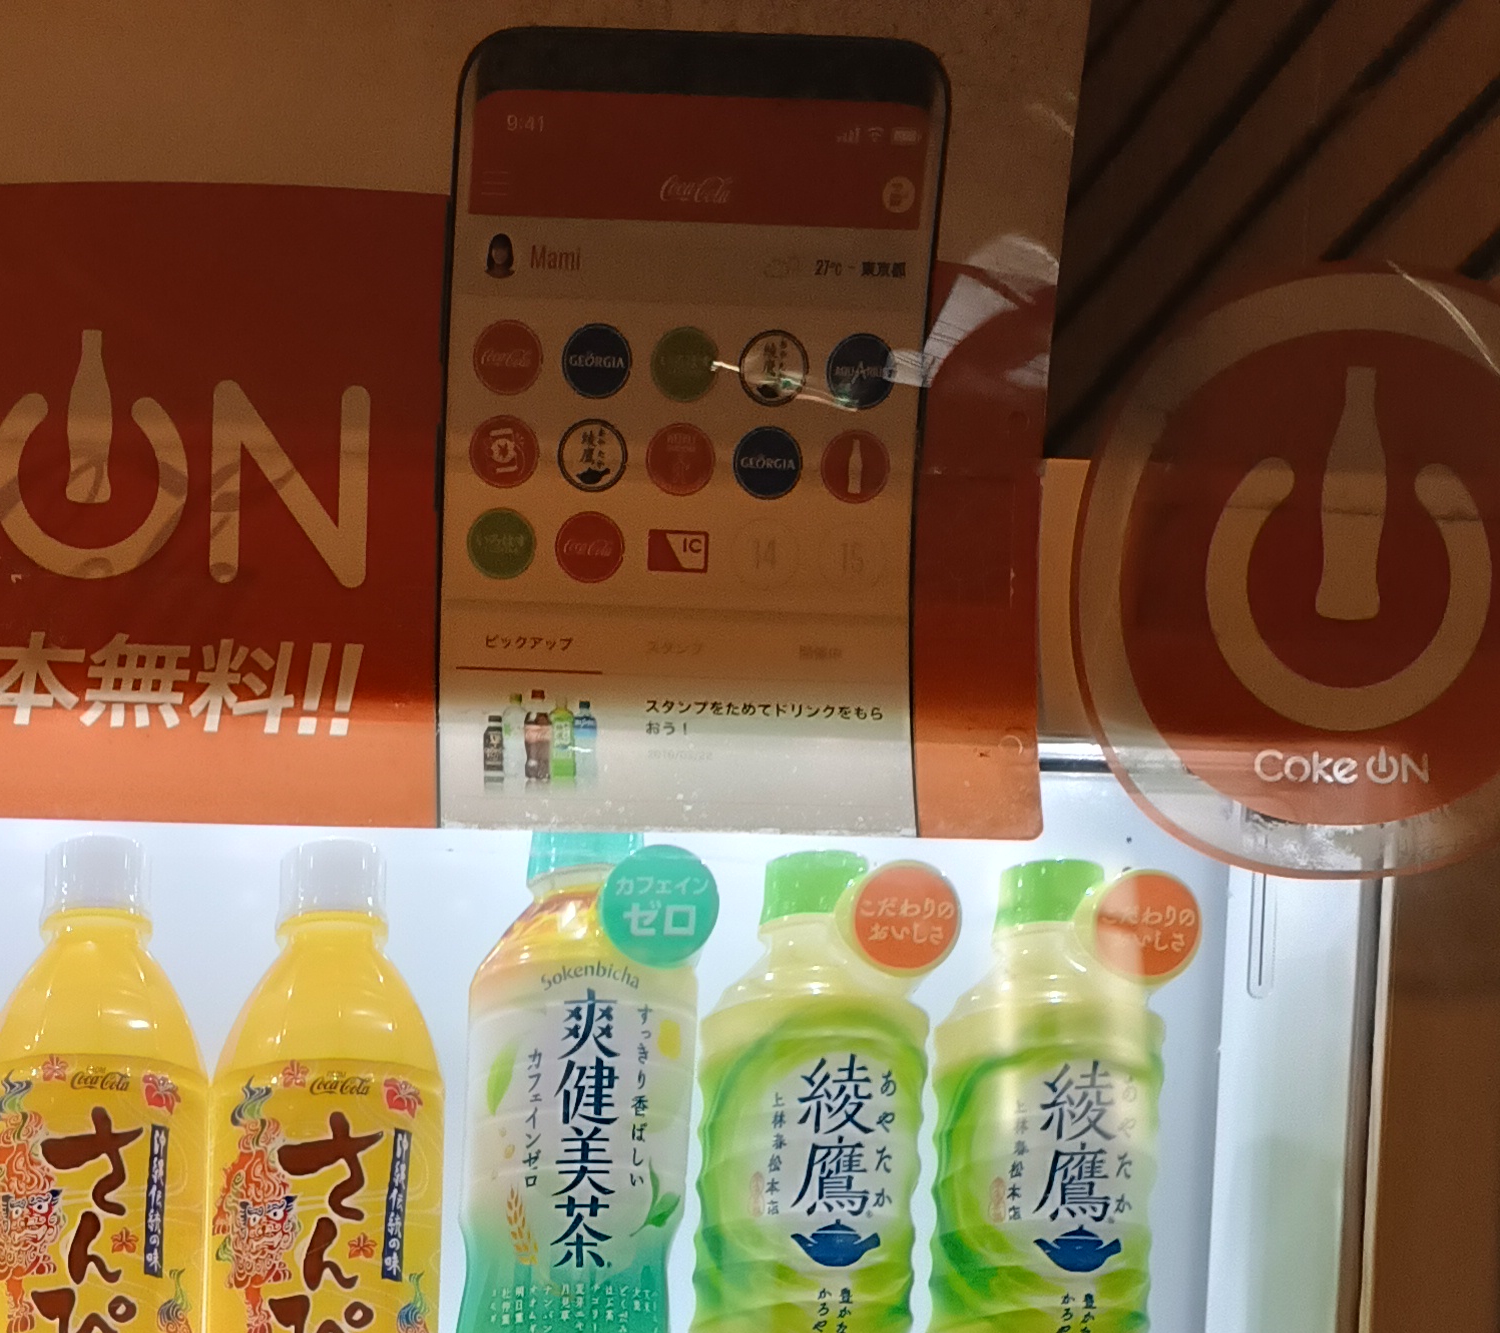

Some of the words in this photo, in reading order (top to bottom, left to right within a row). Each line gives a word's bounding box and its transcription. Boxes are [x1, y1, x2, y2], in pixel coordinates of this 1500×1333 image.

[507, 114, 545, 133] 9:41
[485, 634, 574, 652] ピックアップ
[645, 700, 884, 721] スタンプをためてドリンクをもら
[1254, 749, 1358, 784] Coke
[1366, 746, 1430, 784] ON
[623, 901, 697, 937] ゼロ
[549, 988, 620, 1269] 爽健美茶
[790, 1053, 876, 1218] 綾鷹
[874, 1069, 897, 1207] あやたか
